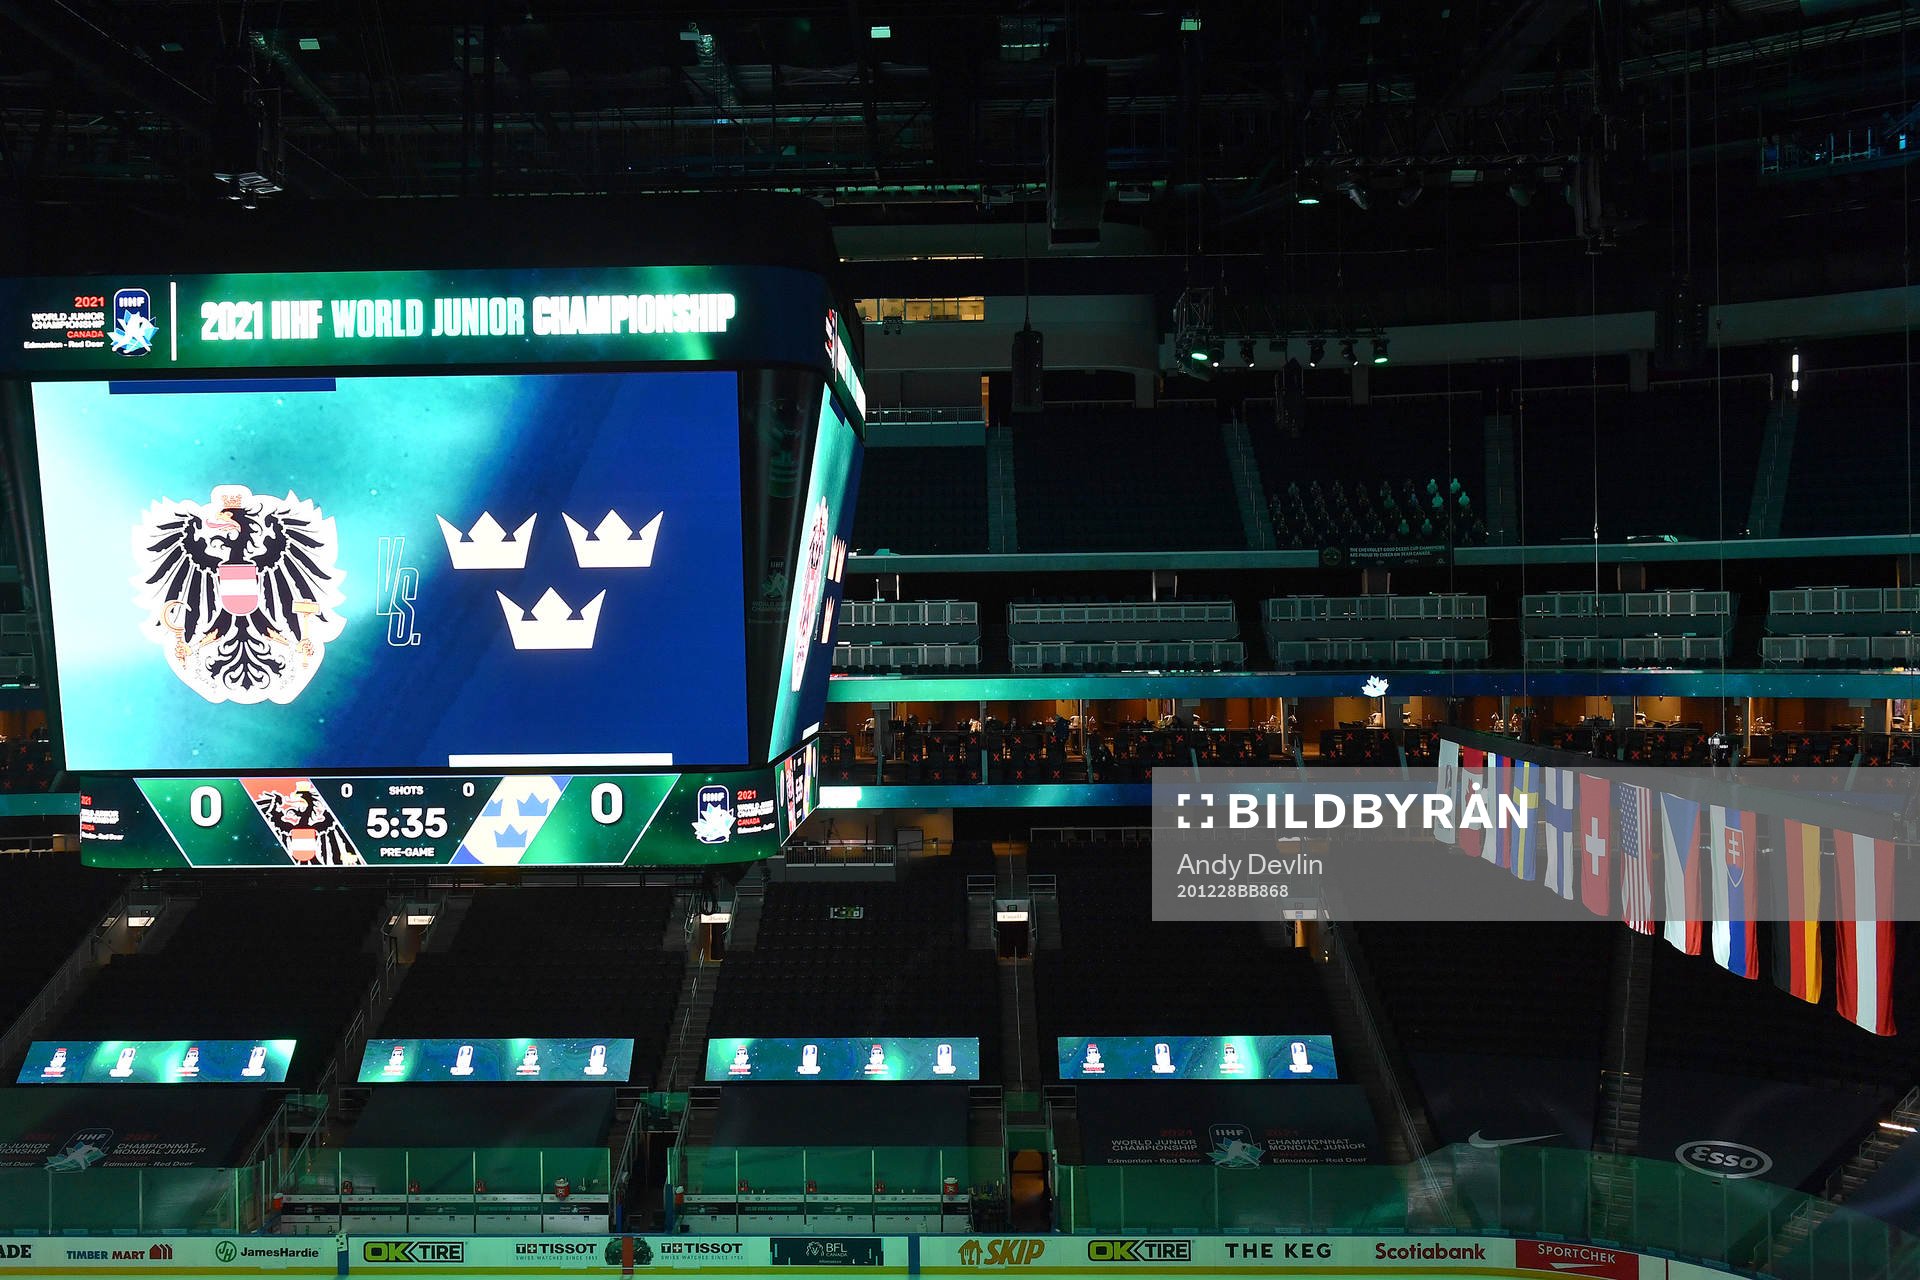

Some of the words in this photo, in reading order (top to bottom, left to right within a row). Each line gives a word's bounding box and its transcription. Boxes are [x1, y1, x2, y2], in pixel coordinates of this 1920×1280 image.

[74, 296, 105, 308] 2021
[119, 297, 145, 308] IIHF
[31, 312, 67, 321] WORLD
[67, 312, 105, 321] JUNIOR
[200, 300, 264, 341] 2021
[271, 300, 323, 340] IIHF
[331, 299, 424, 339] WORLD
[431, 297, 525, 337] JUNIOR
[532, 293, 736, 336] CHAMPIONSHIP
[31, 320, 105, 330] CHAMPIONSHIP
[66, 330, 105, 339] CANADA
[340, 783, 353, 798] 0
[388, 785, 424, 796] SHOTS
[462, 782, 475, 797] 0
[737, 790, 757, 800] 2021
[190, 785, 222, 828] 0
[590, 782, 624, 824] 0
[366, 807, 448, 839] 5:35
[380, 847, 435, 858] PRE-GAME
[241, 1247, 319, 1258] JamesHardie
[365, 1243, 408, 1261] OK
[418, 1244, 460, 1259] TIRE
[539, 1243, 597, 1254] TISSOT
[684, 1243, 743, 1254] TISSOT
[826, 1243, 847, 1253] BFL
[984, 1239, 1045, 1265] SKIP
[1090, 1242, 1132, 1260] OK
[1145, 1243, 1188, 1258] TIRE
[1225, 1243, 1273, 1258] THE
[1285, 1243, 1332, 1258] KEG
[1375, 1242, 1486, 1260] Scotiabank
[66, 1250, 108, 1260] TIMBER
[112, 1250, 145, 1260] MART
